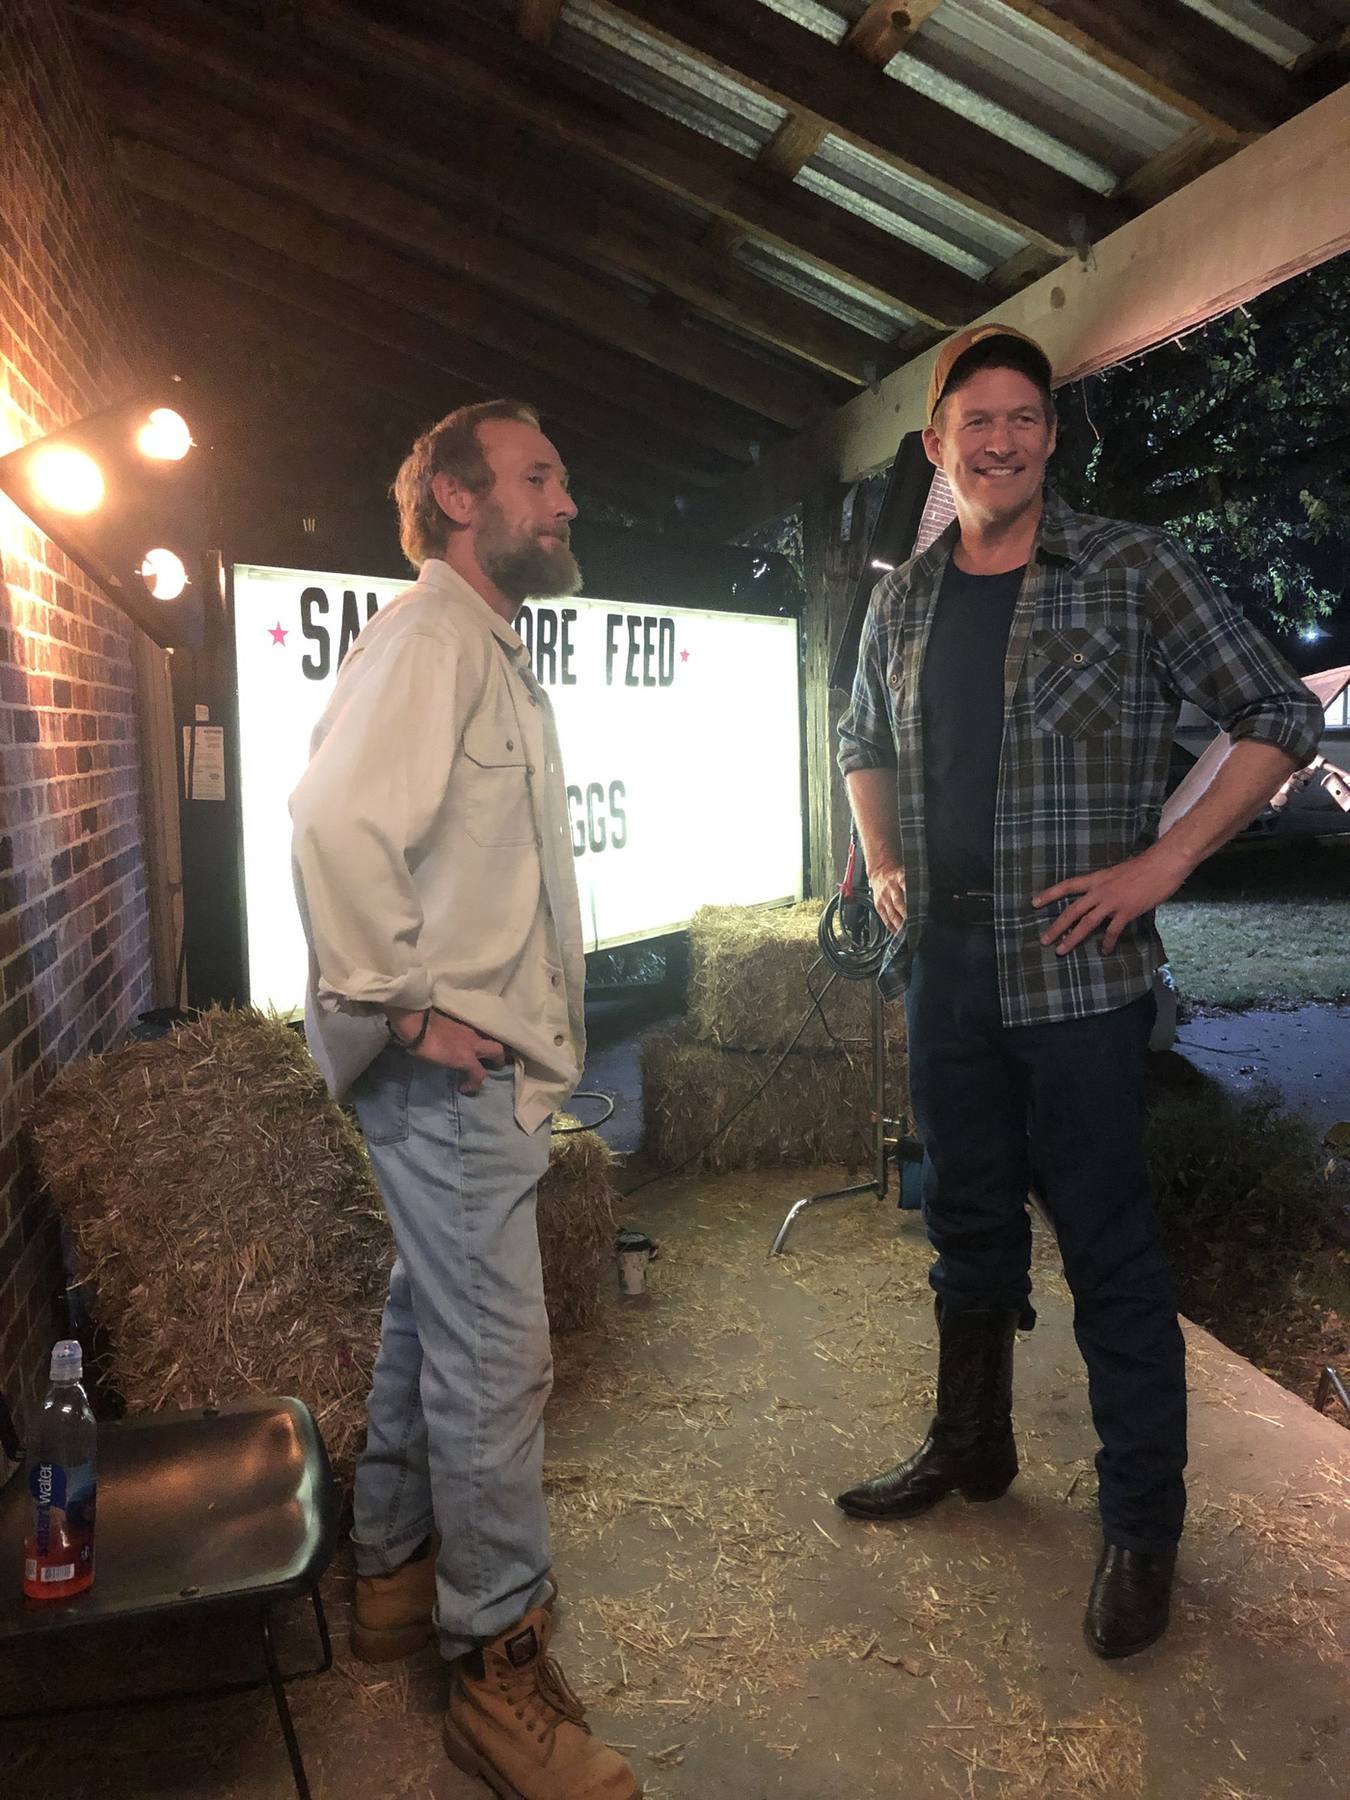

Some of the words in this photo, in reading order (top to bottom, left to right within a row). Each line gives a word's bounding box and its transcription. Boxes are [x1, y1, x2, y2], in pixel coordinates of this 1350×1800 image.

[514, 605, 577, 686] ORE
[606, 613, 675, 687] FEED
[566, 780, 627, 857] GGS
